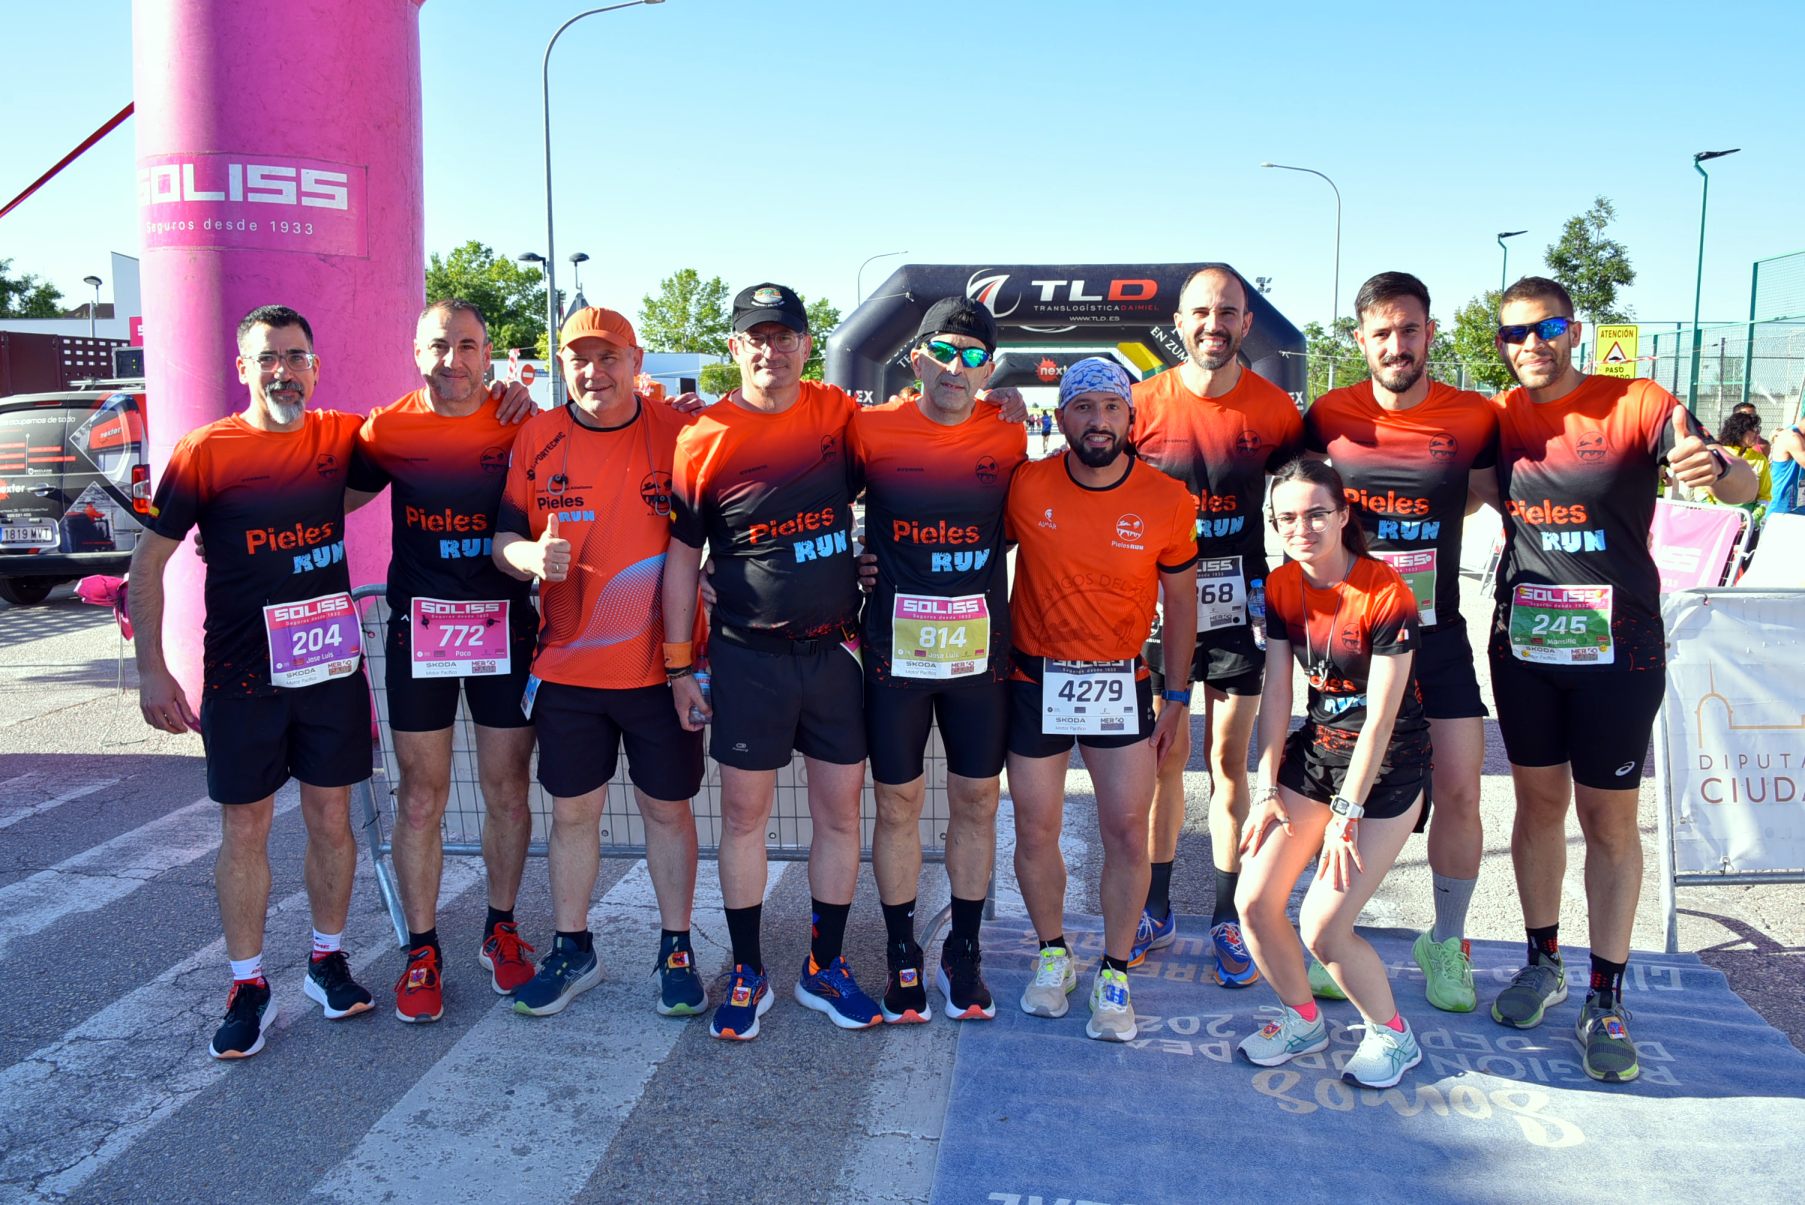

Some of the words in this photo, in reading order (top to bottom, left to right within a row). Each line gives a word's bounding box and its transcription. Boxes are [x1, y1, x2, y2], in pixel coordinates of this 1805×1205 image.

[203, 218, 258, 231] desde
[270, 220, 313, 235] 1933
[1031, 279, 1158, 302] TLD
[1151, 326, 1165, 342] EN
[1165, 338, 1189, 363] ZUM
[1601, 328, 1634, 338] ATENCIÓN
[1040, 365, 1068, 376] next
[537, 496, 584, 511] Pieles
[1343, 487, 1430, 515] Pieles
[1505, 499, 1588, 526] Pieles
[406, 504, 488, 532] Pieles
[748, 507, 836, 545] Pieles
[1196, 516, 1245, 538] RUN
[5, 529, 28, 540] 1819
[246, 522, 334, 555] Pieles
[893, 520, 981, 544] Pieles
[1378, 520, 1440, 541] RUN
[1541, 529, 1606, 553] RUN
[293, 540, 344, 574] RUN
[793, 529, 849, 563] RUN
[931, 548, 990, 573] RUN
[274, 597, 349, 622] SOLISS
[421, 601, 500, 614] SOLISS
[903, 599, 979, 615] SOLISS
[439, 625, 485, 647] 772
[1531, 614, 1588, 635] 245
[292, 623, 343, 656] 204
[918, 626, 967, 649] 814
[1058, 680, 1123, 702] 4279
[1133, 1013, 1237, 1038] 202
